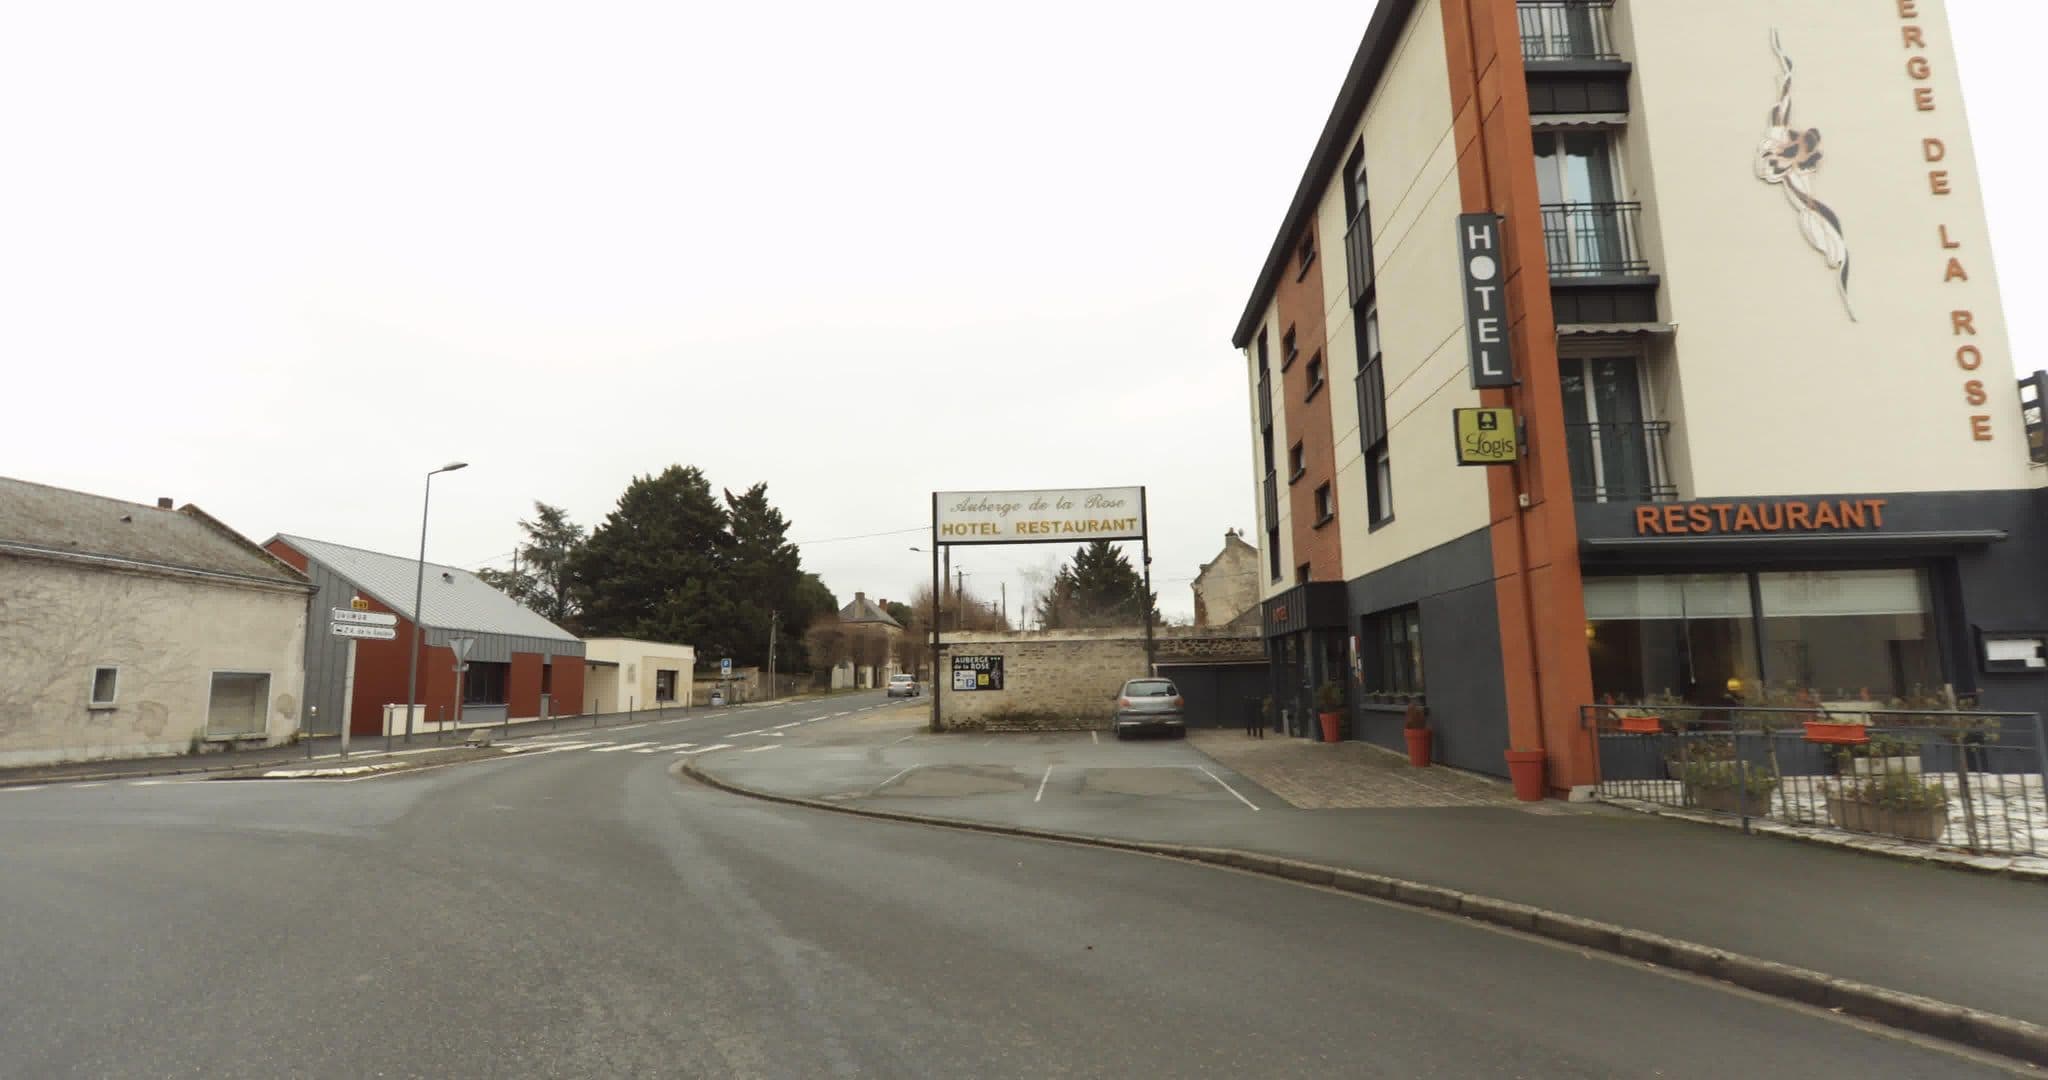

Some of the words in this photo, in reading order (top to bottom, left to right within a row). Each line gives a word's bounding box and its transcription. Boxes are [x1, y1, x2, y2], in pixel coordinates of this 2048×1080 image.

[1922, 137, 1951, 196] DE
[1937, 223, 1969, 283] LA
[1467, 224, 1503, 377] HOTEL
[1950, 310, 1994, 442] ROSE
[1464, 431, 1514, 458] Logis
[941, 521, 1002, 536] HOTEL
[1015, 517, 1138, 535] RESTAURANT
[950, 495, 1022, 517] Auberge
[1028, 495, 1049, 512] de
[1055, 494, 1073, 511] la
[1083, 493, 1126, 510] Rose
[1635, 498, 1888, 535] RESTAURANT
